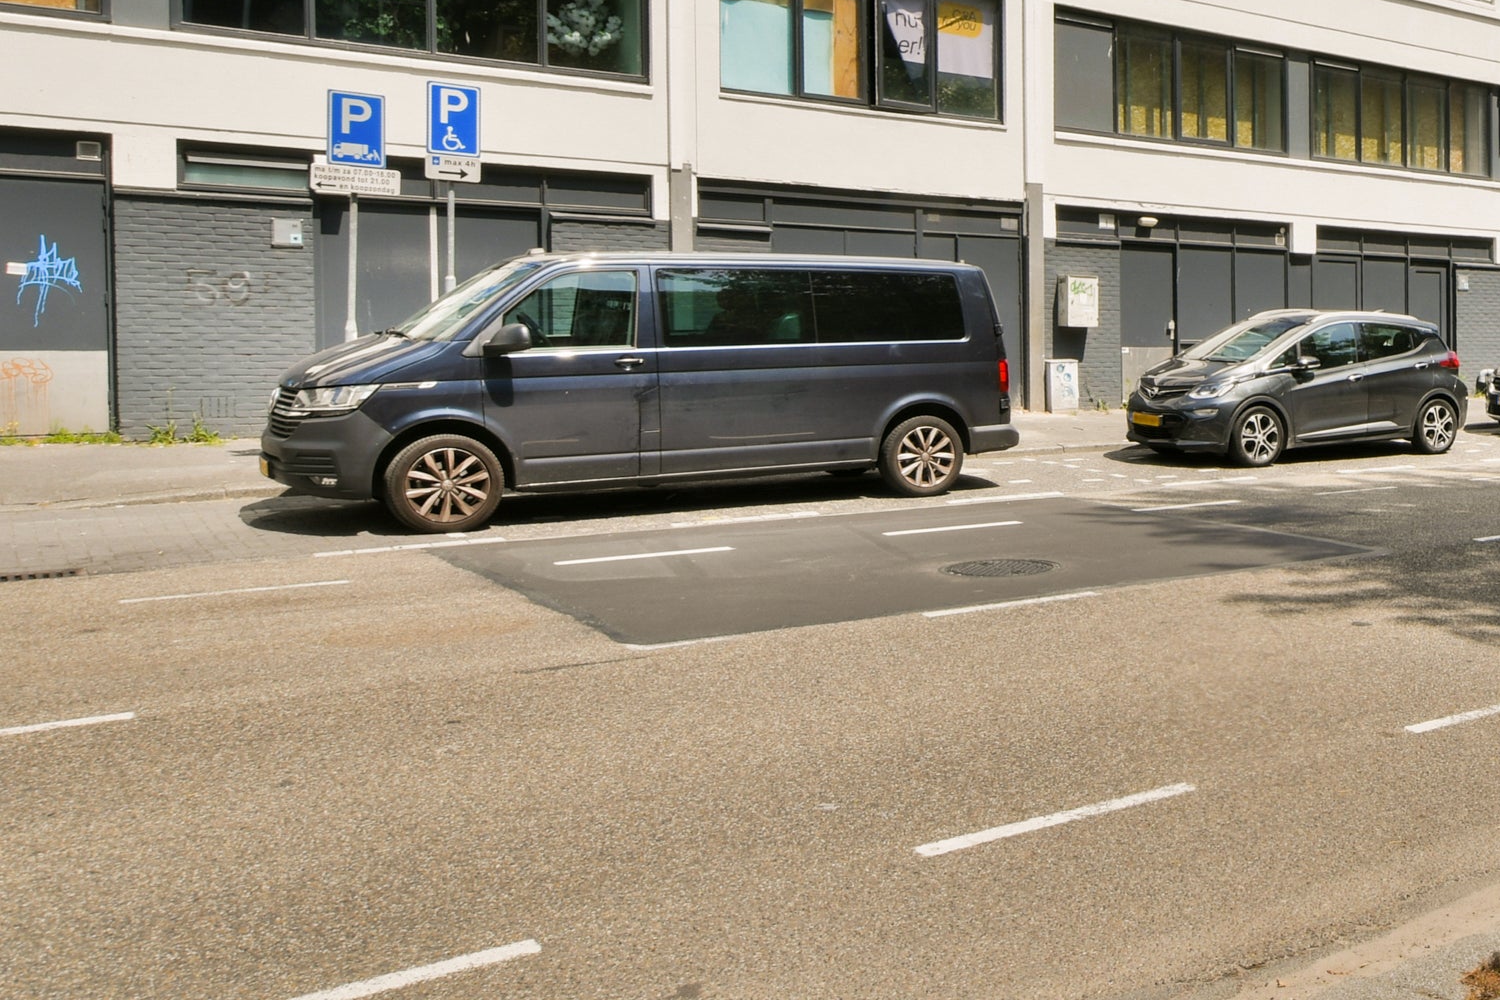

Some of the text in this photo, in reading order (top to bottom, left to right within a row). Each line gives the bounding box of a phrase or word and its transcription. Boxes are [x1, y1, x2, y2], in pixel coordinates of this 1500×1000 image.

[956, 20, 977, 31] you
[341, 97, 372, 134] P
[440, 88, 469, 124] P
[314, 173, 355, 183] koopavond
